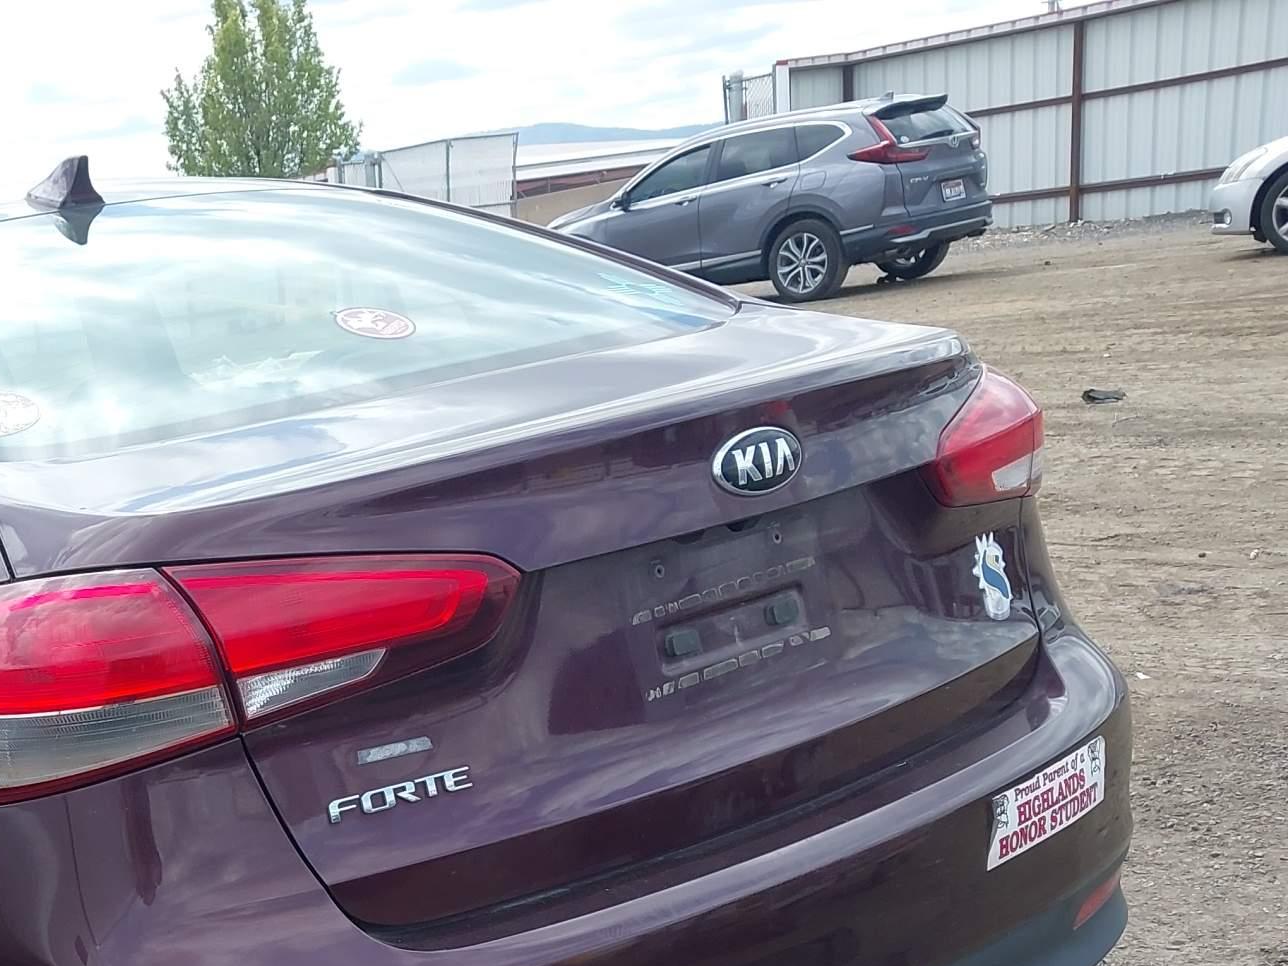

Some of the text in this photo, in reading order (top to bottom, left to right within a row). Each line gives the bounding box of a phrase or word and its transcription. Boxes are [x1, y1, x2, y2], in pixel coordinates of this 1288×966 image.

[732, 437, 795, 486] KIA
[328, 766, 473, 824] FORTE
[1014, 775, 1040, 801] Proud
[1043, 761, 1069, 786] Parent
[1071, 752, 1081, 769] of
[1016, 767, 1086, 826] HIGHLANDS
[998, 782, 1098, 860] HONOR STUDENT
